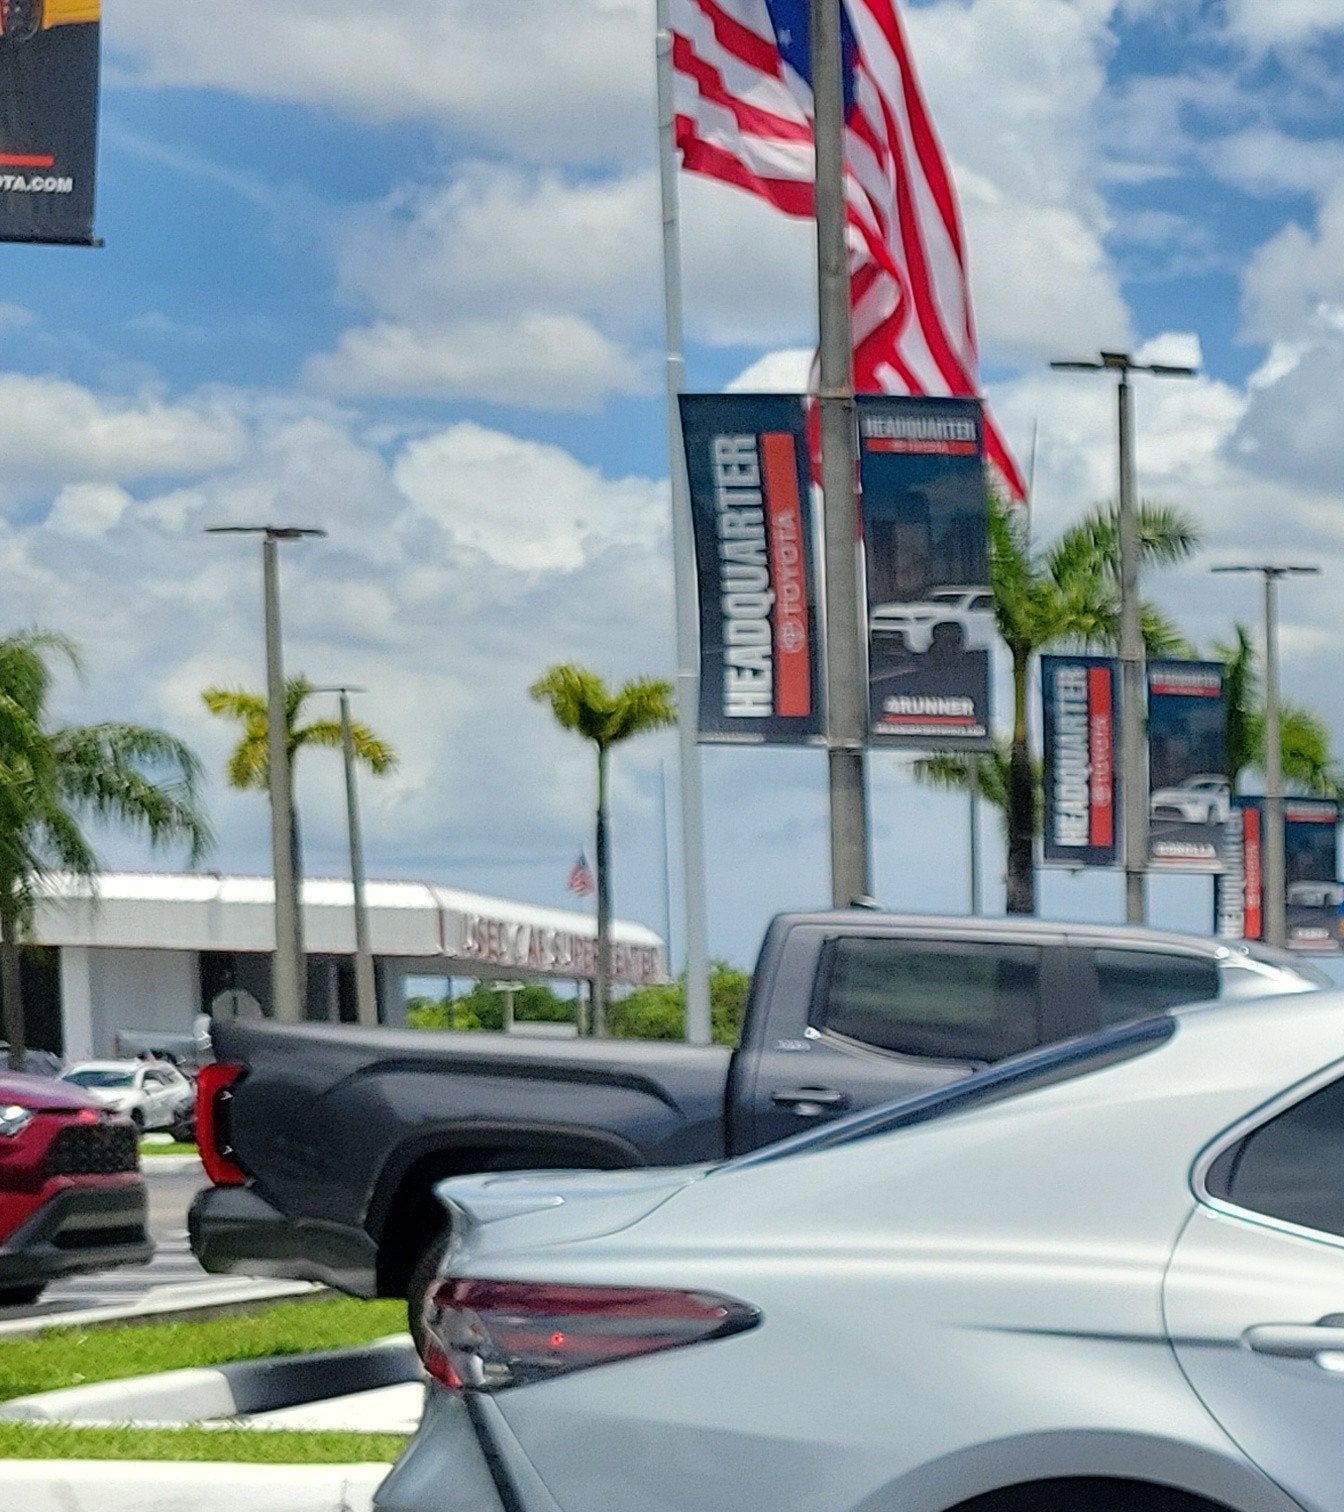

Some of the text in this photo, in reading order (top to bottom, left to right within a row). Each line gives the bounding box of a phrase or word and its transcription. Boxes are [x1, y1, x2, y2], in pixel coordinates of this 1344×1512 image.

[713, 434, 773, 718] HEADQUARTER
[776, 510, 801, 614] TOYOTA
[884, 696, 975, 715] 4RUNNER
[1055, 667, 1089, 846] HEADQUARTER
